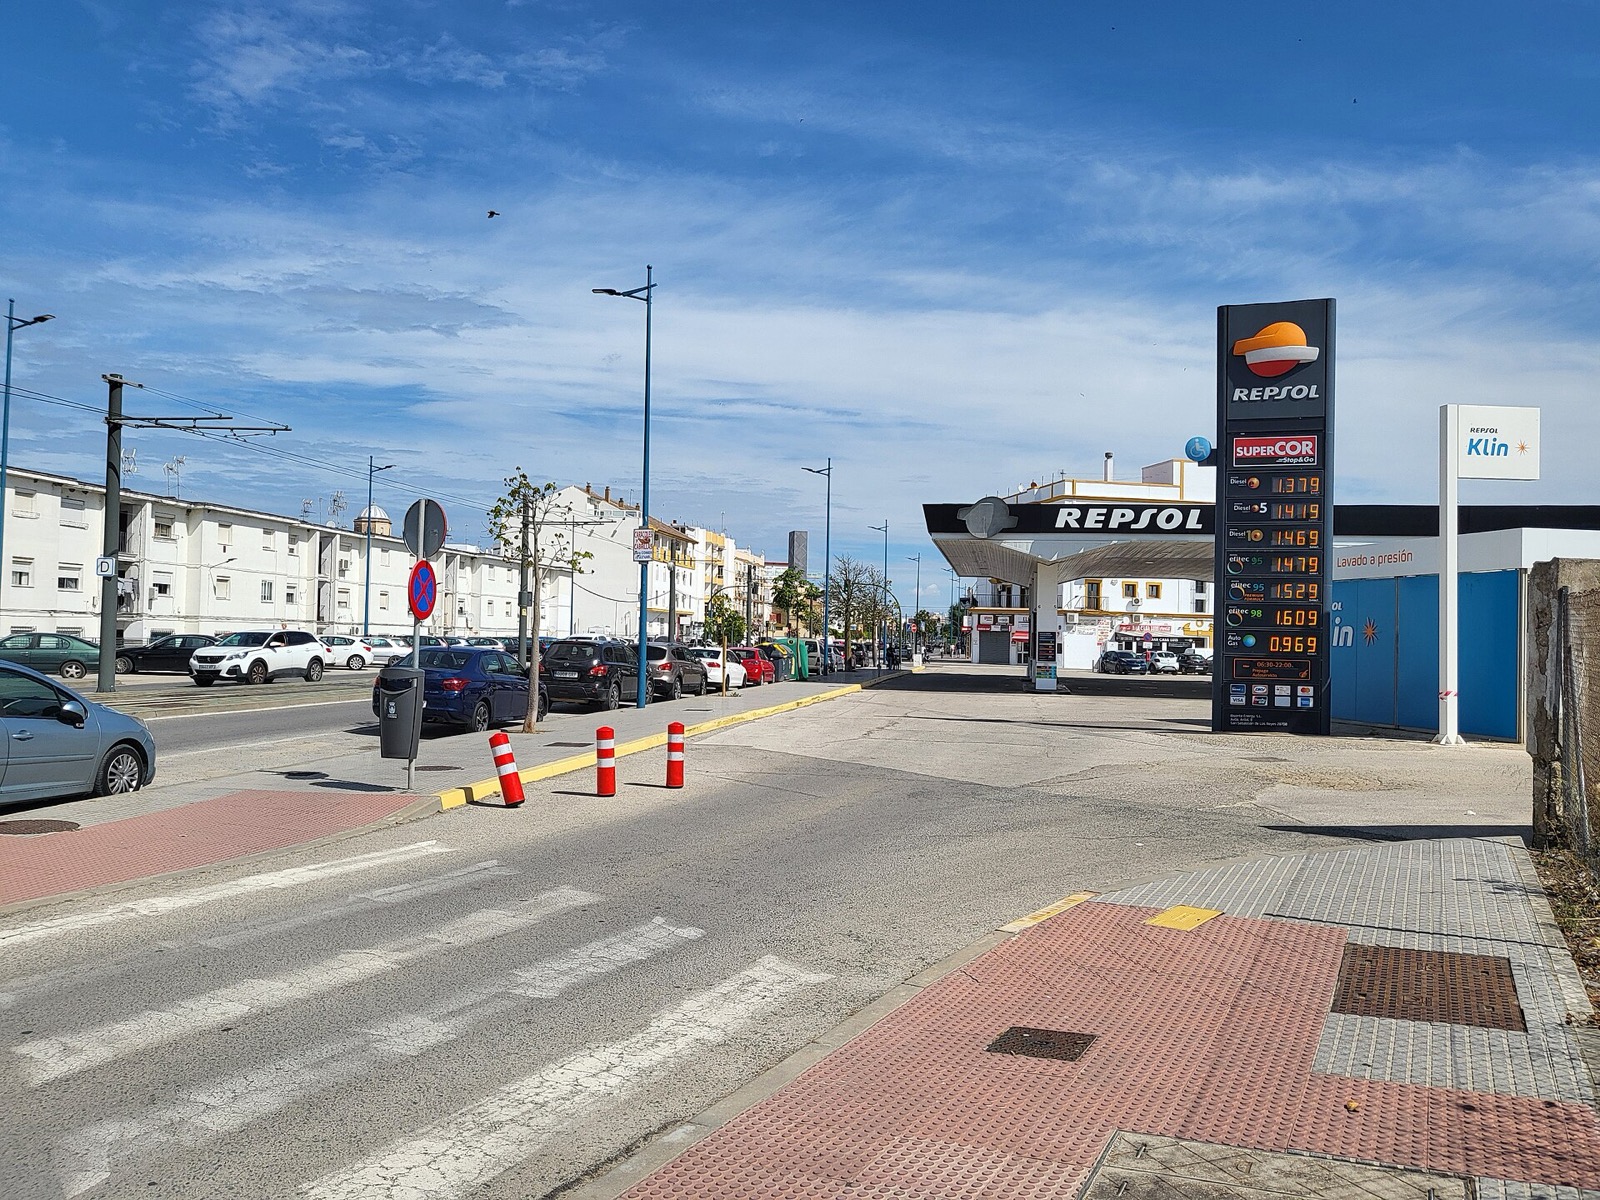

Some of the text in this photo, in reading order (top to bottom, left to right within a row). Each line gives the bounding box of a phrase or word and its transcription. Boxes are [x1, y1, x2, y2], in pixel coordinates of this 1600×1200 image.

[1233, 385, 1319, 401] REPSOL
[1236, 441, 1314, 456] SUPERCOR
[1467, 437, 1509, 457] Klin
[1259, 502, 1268, 514] 5
[1055, 508, 1203, 529] REPSOL
[1251, 557, 1263, 565] 95
[1337, 549, 1413, 568] Lavado a presión
[101, 561, 109, 572] D
[1252, 583, 1265, 592] 95
[1250, 609, 1263, 618] 98
